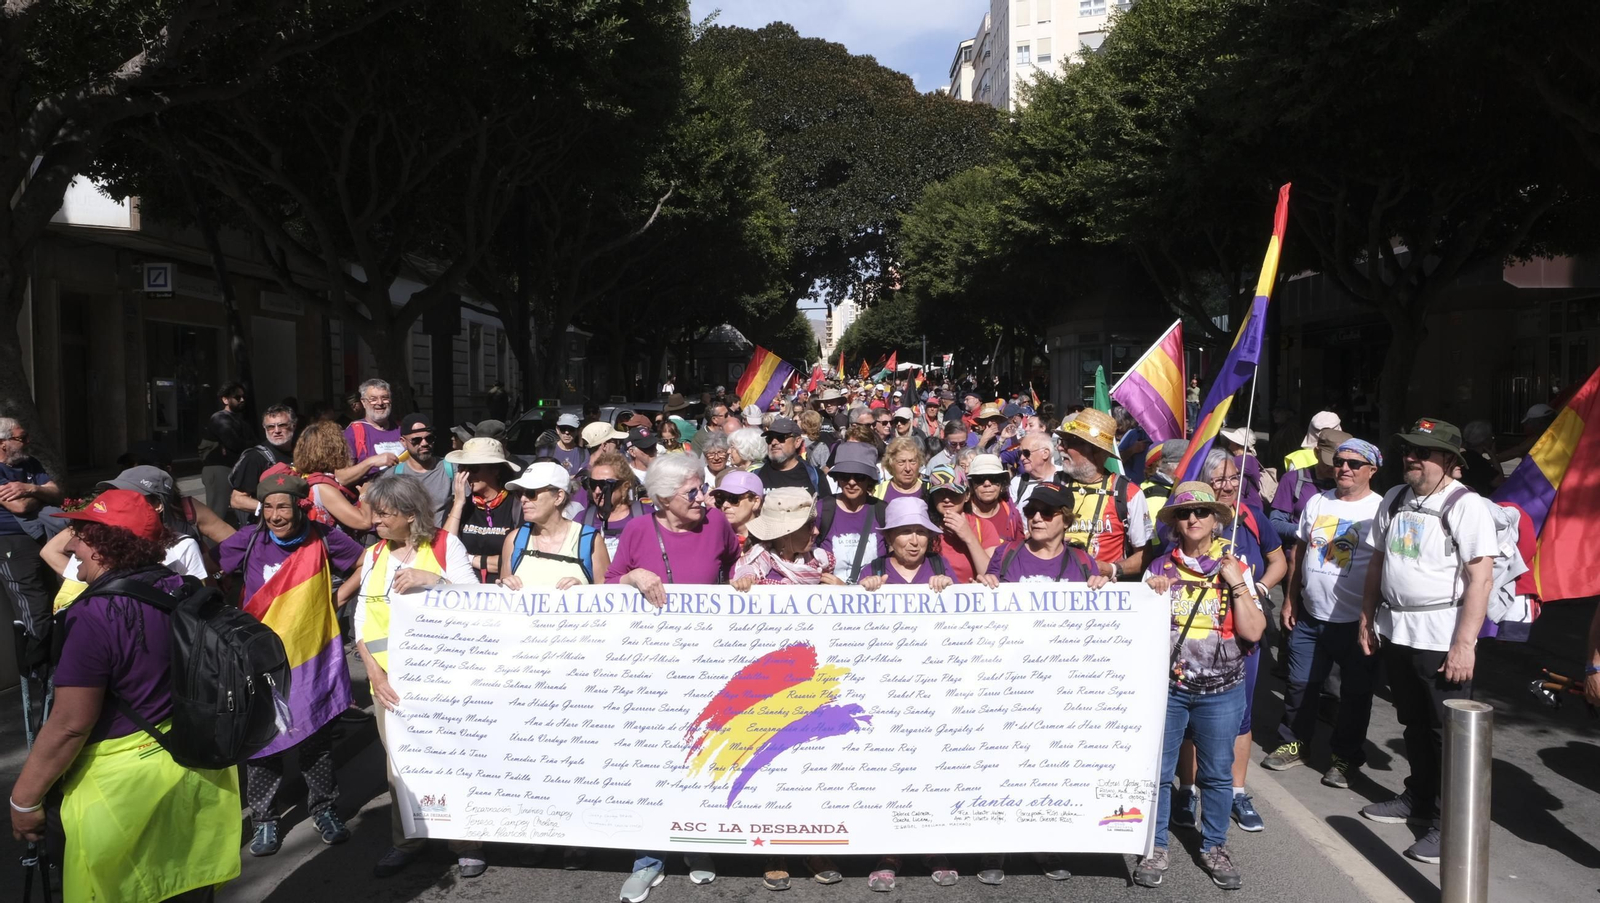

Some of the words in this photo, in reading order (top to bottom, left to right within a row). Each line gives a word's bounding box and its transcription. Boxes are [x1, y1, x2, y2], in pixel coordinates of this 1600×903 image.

[423, 588, 550, 616] HOMENAJE
[555, 594, 570, 613] A
[576, 593, 614, 613] LAS
[728, 594, 762, 614] DE
[768, 594, 800, 614] LA
[807, 593, 948, 614] CARRETERA
[954, 592, 986, 613] DE
[992, 592, 1023, 612] LA
[1029, 590, 1132, 612] MUERTE
[968, 795, 1023, 808] tantas
[670, 822, 707, 832] ASC
[718, 823, 743, 832] LA
[750, 821, 849, 834] DESBANDÁ
